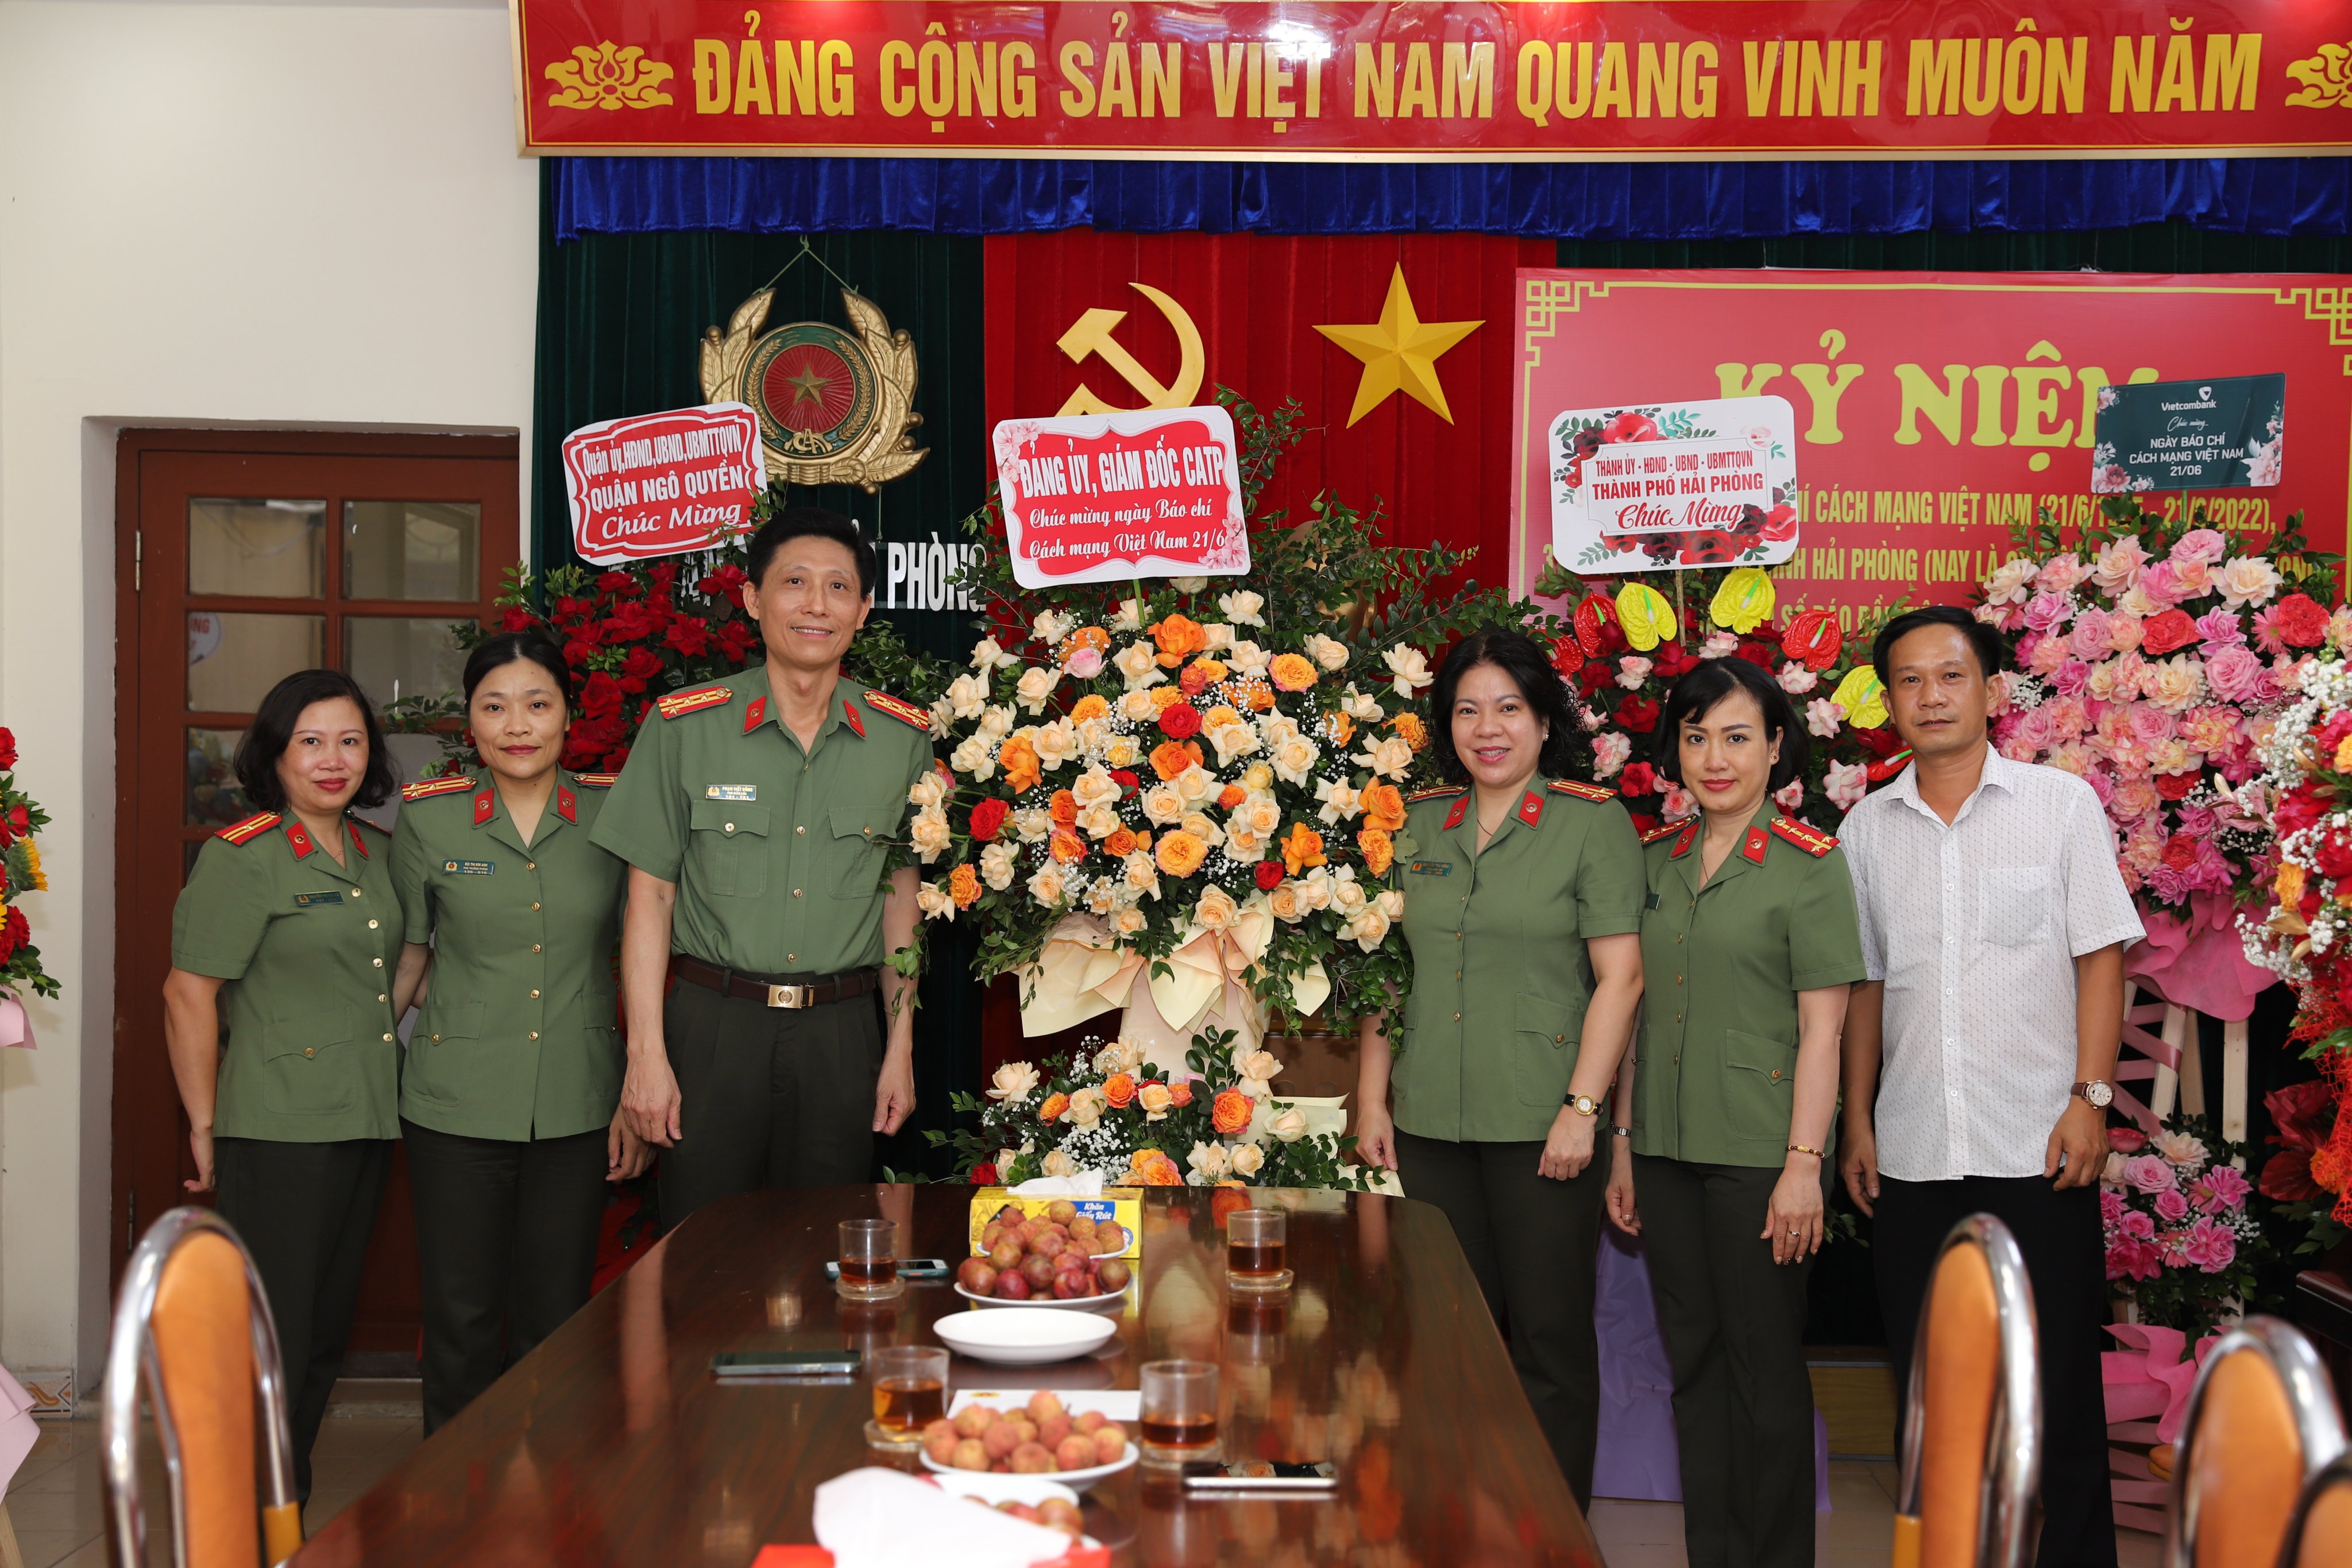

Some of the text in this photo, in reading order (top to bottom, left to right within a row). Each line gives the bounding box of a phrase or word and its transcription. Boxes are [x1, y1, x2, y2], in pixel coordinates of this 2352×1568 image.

[693, 10, 2263, 133] ĐẢNG CỘNG SẢN VIỆT NAM QUANG VINH MUÔN NĂM
[2161, 399, 2216, 411] Vietcombank
[2129, 447, 2245, 465] CÁCH MẠNG VIỆT NAM
[2150, 432, 2226, 449] NGÀY BÁO CHÍ
[582, 446, 610, 481] Quận
[1019, 434, 1225, 499] ĐẢNG ỦY, GIÁM ĐỐC CATP
[1596, 456, 1623, 477] THÀNH
[1625, 453, 1636, 476] ỦY
[1643, 455, 1667, 474] HĐND
[1675, 453, 1698, 472] UBND
[1707, 450, 1754, 470] UBMTTQVN
[2169, 464, 2203, 477] 21/06
[590, 459, 744, 515] QUẬN NGÔ QUYỀN
[1592, 470, 1764, 500] THÀNH PHỐ HẢI PHÒNG
[601, 504, 741, 540] Chúc Mừng
[1029, 497, 1213, 529] Chúc mừng ngày Báo chí
[1615, 497, 1744, 530] Chúc Mừng
[1816, 484, 1868, 523] CÁCH
[1874, 491, 1933, 531] MẠNG
[1939, 485, 1981, 532] VIỆT
[1985, 493, 2033, 526] NAM
[1029, 527, 1226, 561] Cách mạng Việt Nam 21/6
[1812, 537, 1844, 580] HẢI
[1851, 540, 1918, 581] PHÒNG
[1925, 549, 1970, 585] (NAY
[1083, 1202, 1105, 1210] Khăn
[1095, 1211, 1113, 1220] Rút
